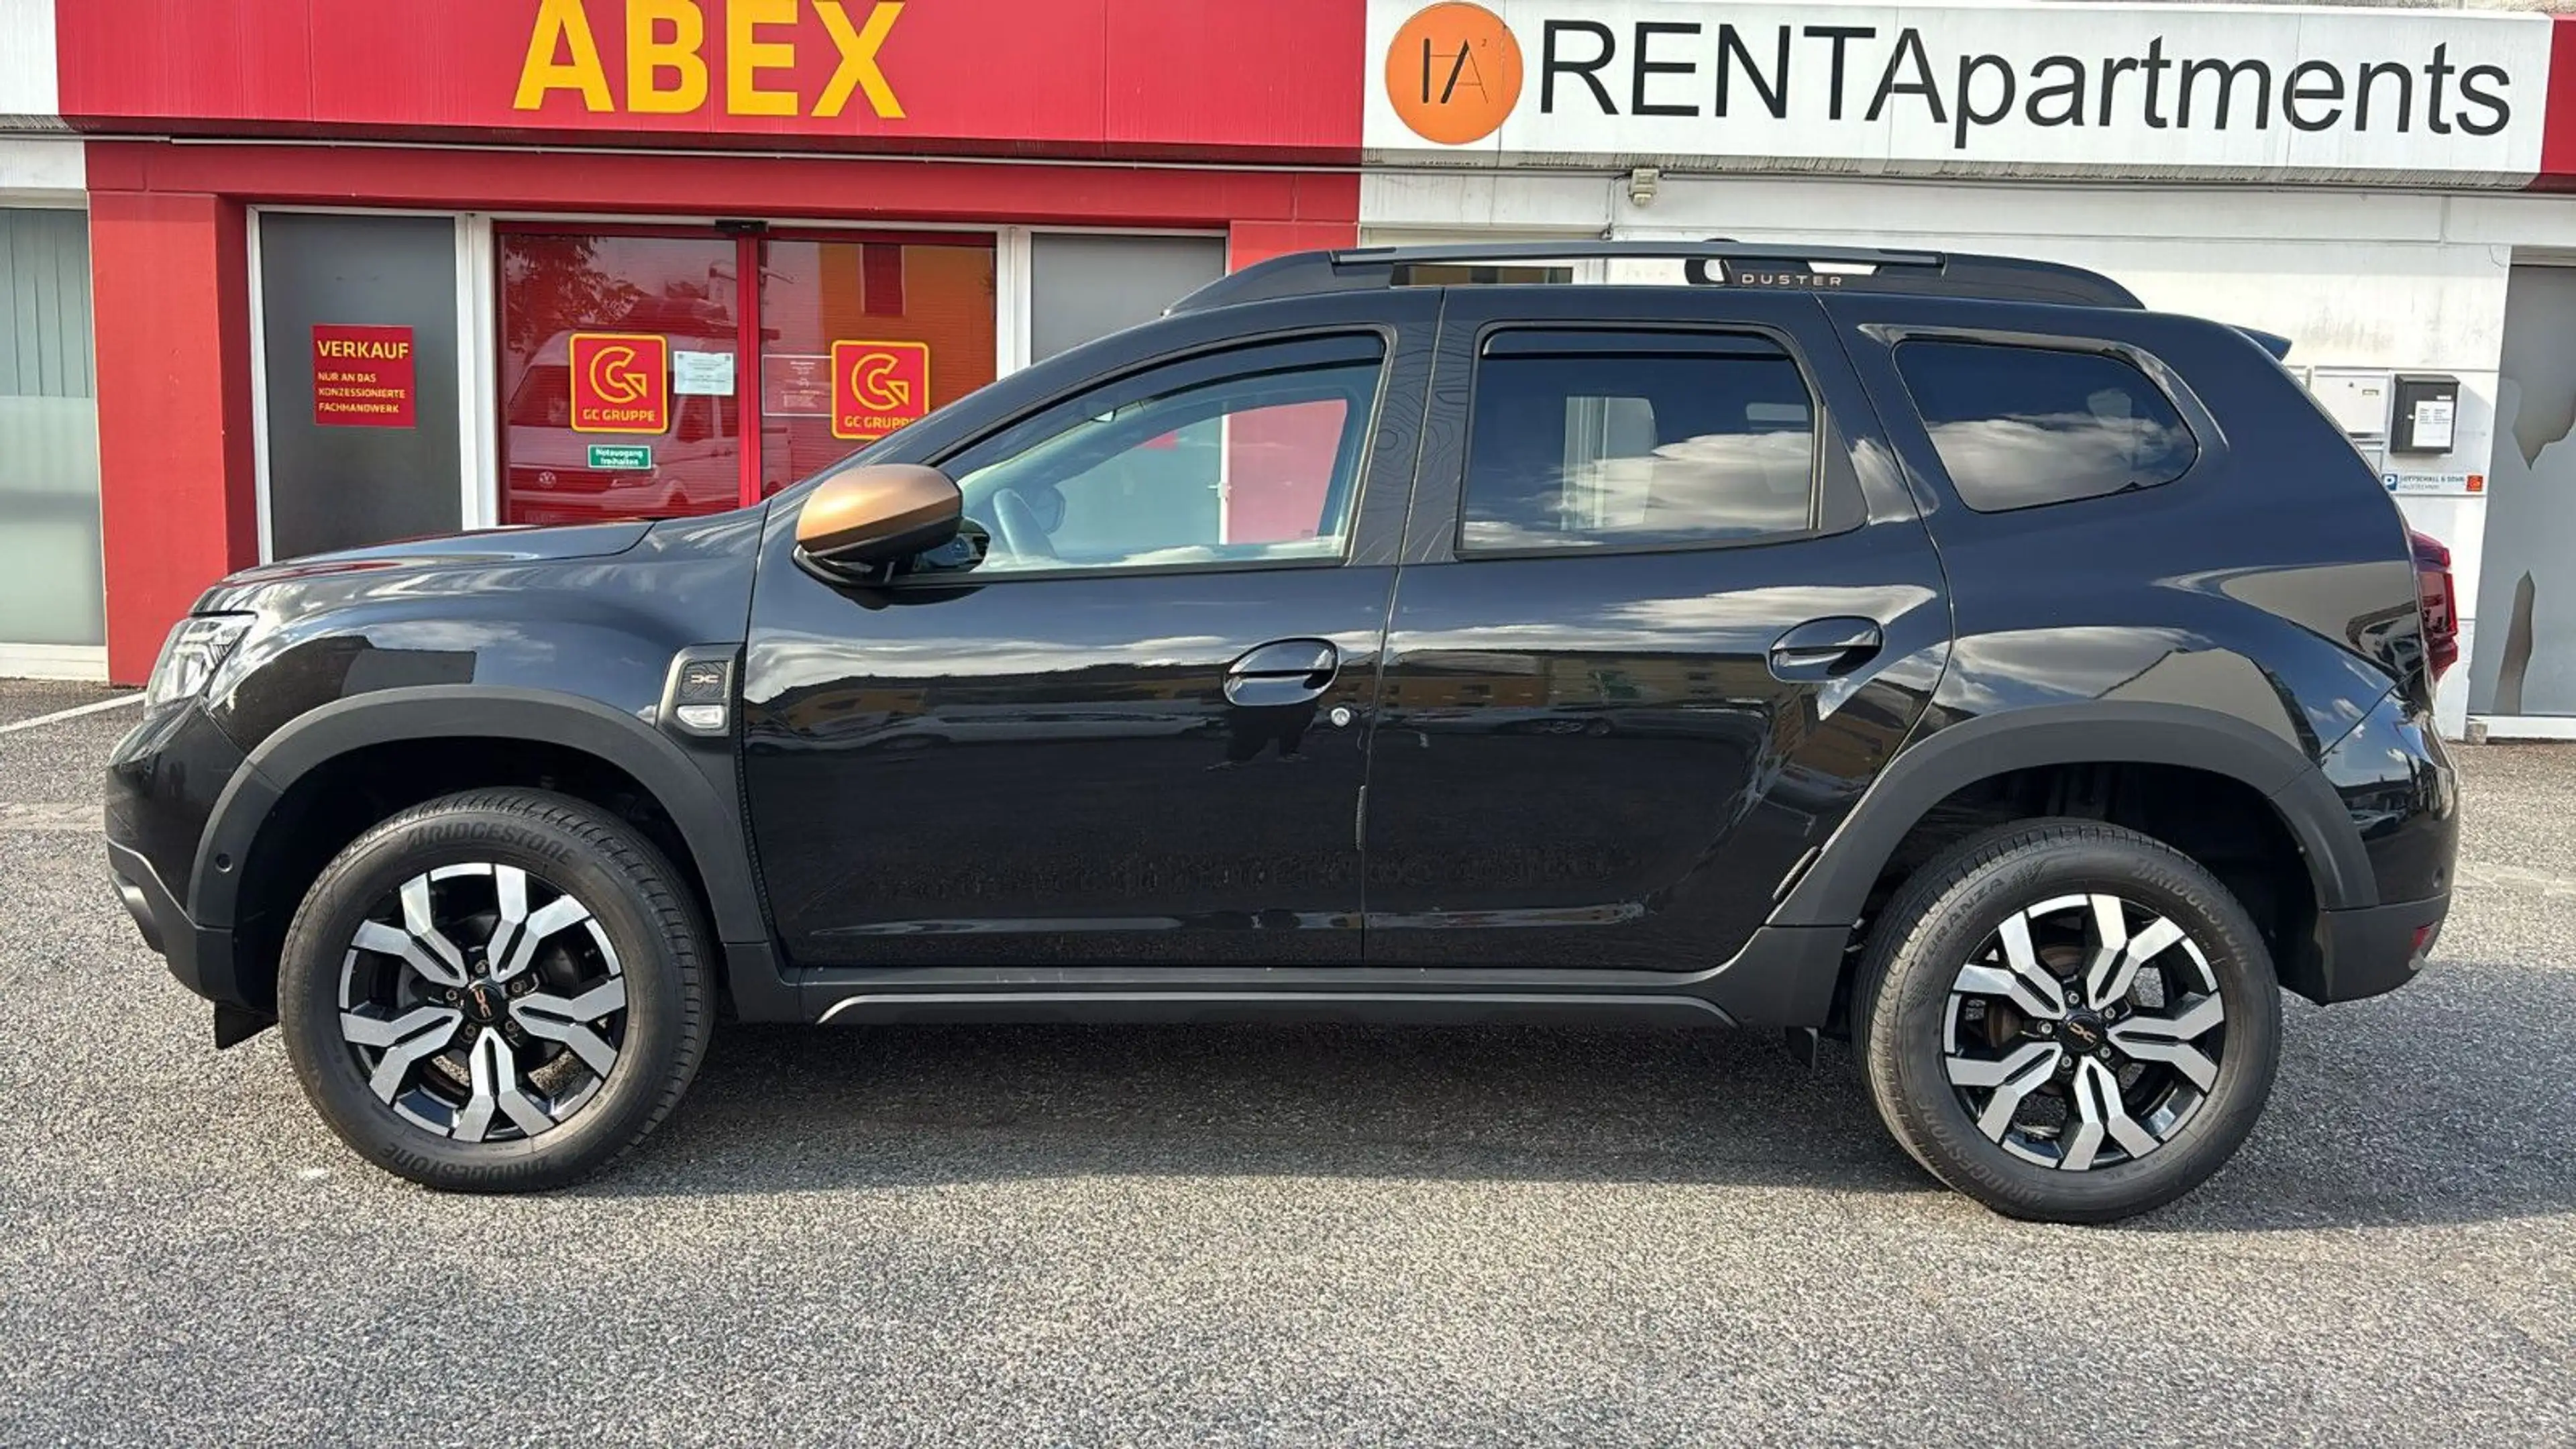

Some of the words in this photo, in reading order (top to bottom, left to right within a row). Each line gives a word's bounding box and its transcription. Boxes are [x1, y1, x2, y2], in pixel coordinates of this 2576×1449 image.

[514, 0, 906, 119] ABEX
[1540, 19, 2510, 150] RENTApartments
[1741, 274, 1842, 286] DUSTER
[317, 339, 409, 359] VERKAUF
[318, 372, 339, 382] NUR
[341, 373, 355, 382] AN
[357, 374, 376, 383] DAS
[318, 387, 406, 398] KONZESSIONIERTE
[318, 402, 399, 413] FACHHANDWERK
[582, 409, 600, 420] GC
[602, 409, 655, 422] GRUPPE
[844, 415, 862, 427] GC
[863, 417, 915, 429] GRUPP
[405, 821, 577, 866] BRIDGESTONE
